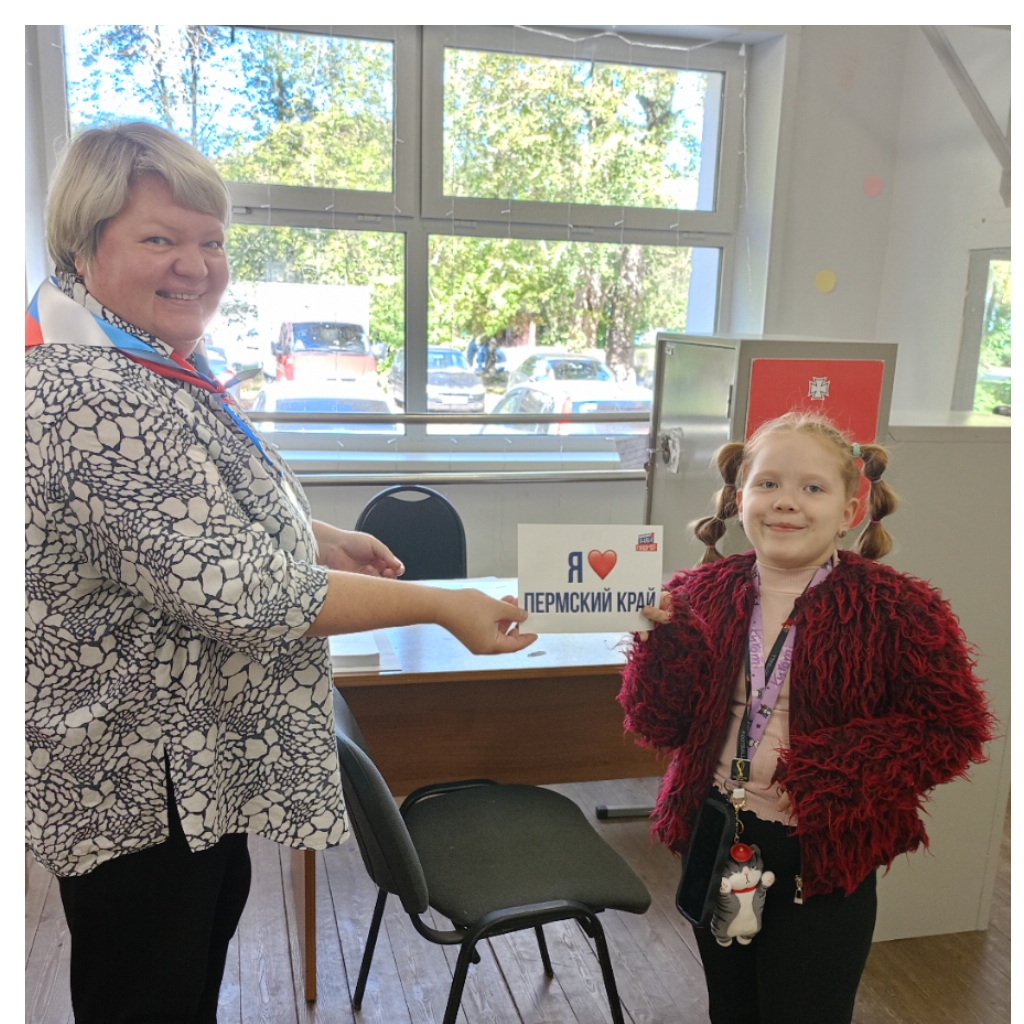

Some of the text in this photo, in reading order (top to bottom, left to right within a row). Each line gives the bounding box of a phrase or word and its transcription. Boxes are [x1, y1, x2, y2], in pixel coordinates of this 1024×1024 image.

[568, 551, 583, 583] Я
[524, 587, 656, 613] ПЕРМСКИЙ КРАЙ
